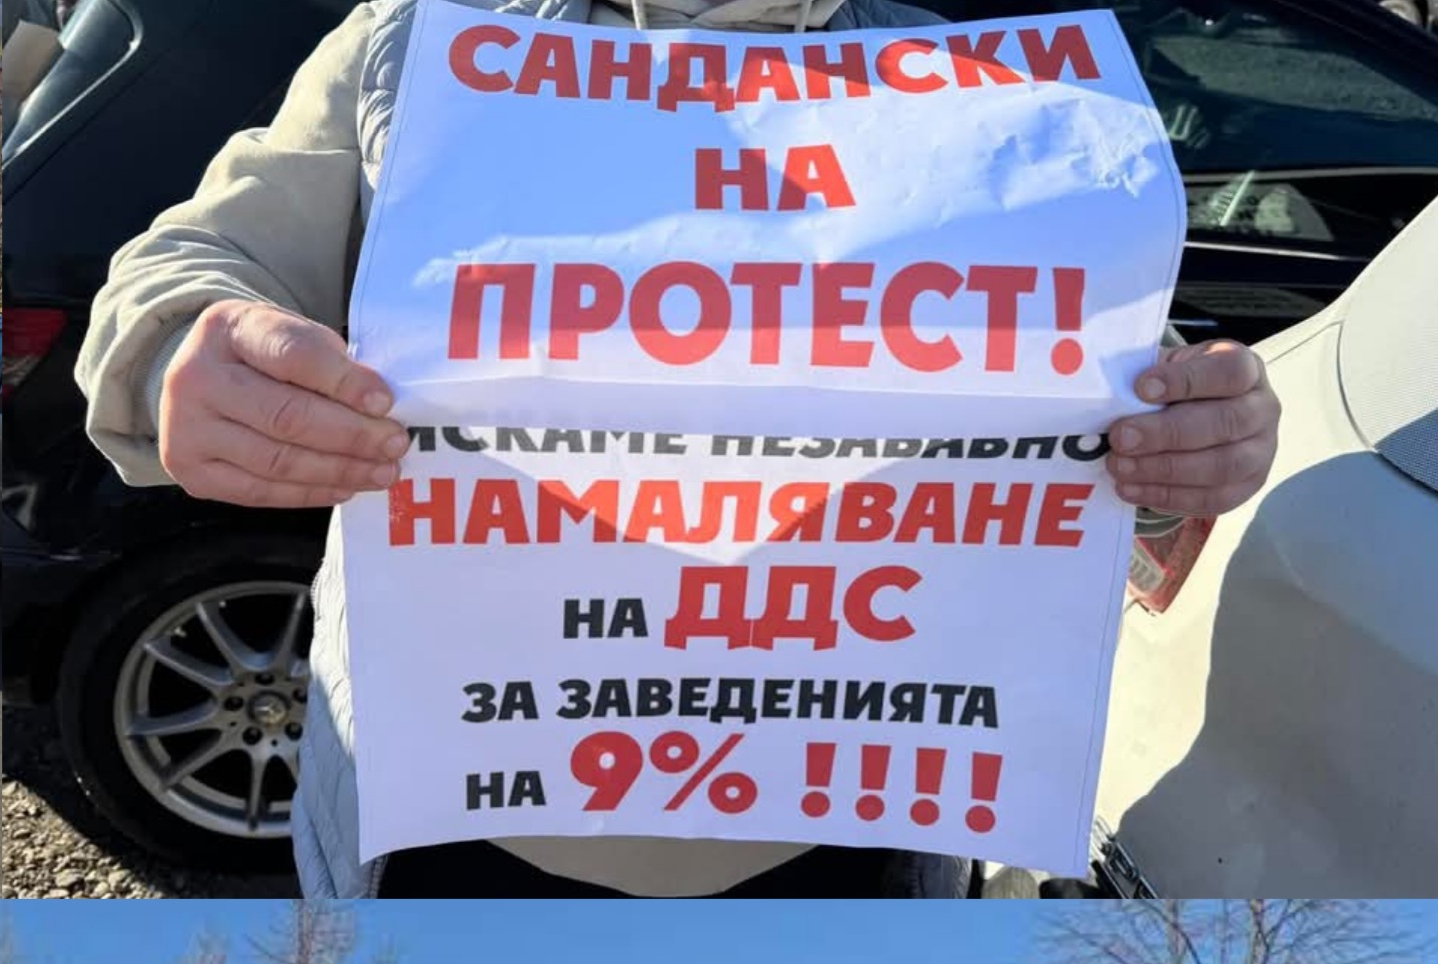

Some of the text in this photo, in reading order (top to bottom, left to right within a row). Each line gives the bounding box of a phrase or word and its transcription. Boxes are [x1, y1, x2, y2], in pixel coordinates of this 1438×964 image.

[449, 24, 1102, 112] САНДАНСКИ
[694, 144, 856, 211] НА
[448, 261, 1087, 376] ПРОТЕСТ!
[388, 478, 1095, 547] НАМАЛЯВАНЕ
[562, 565, 923, 652] НА ДДС
[461, 678, 999, 729] ЗА ЗАВЕДЕНИЯТА
[466, 731, 1004, 833] НА 9% !!!!
